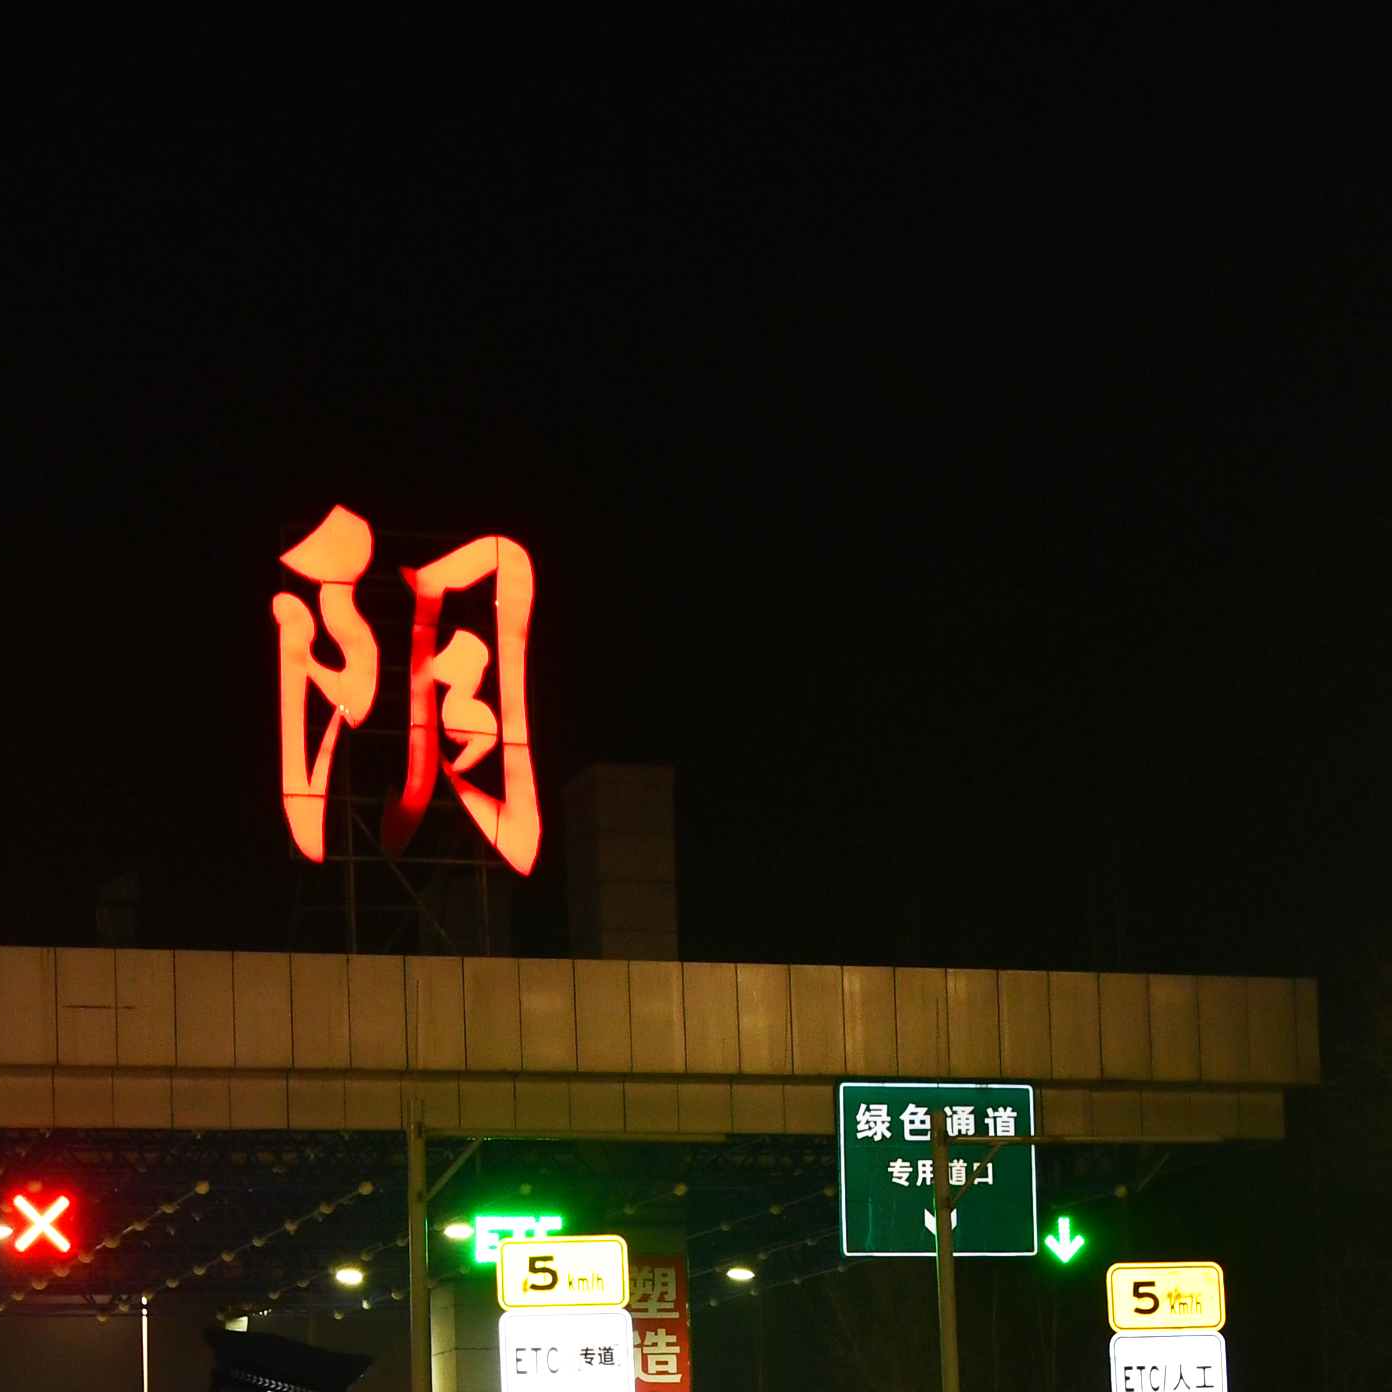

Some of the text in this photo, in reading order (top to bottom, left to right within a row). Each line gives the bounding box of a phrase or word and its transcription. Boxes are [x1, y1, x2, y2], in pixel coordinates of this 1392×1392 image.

[856, 1102, 1018, 1141] 绿色通道
[887, 1157, 994, 1187] 专用道口
[528, 1254, 605, 1292] 5 km/h
[1132, 1280, 1160, 1315] 5
[515, 1346, 615, 1374] ETC 专道
[1123, 1364, 1215, 1392] ETC/人工
